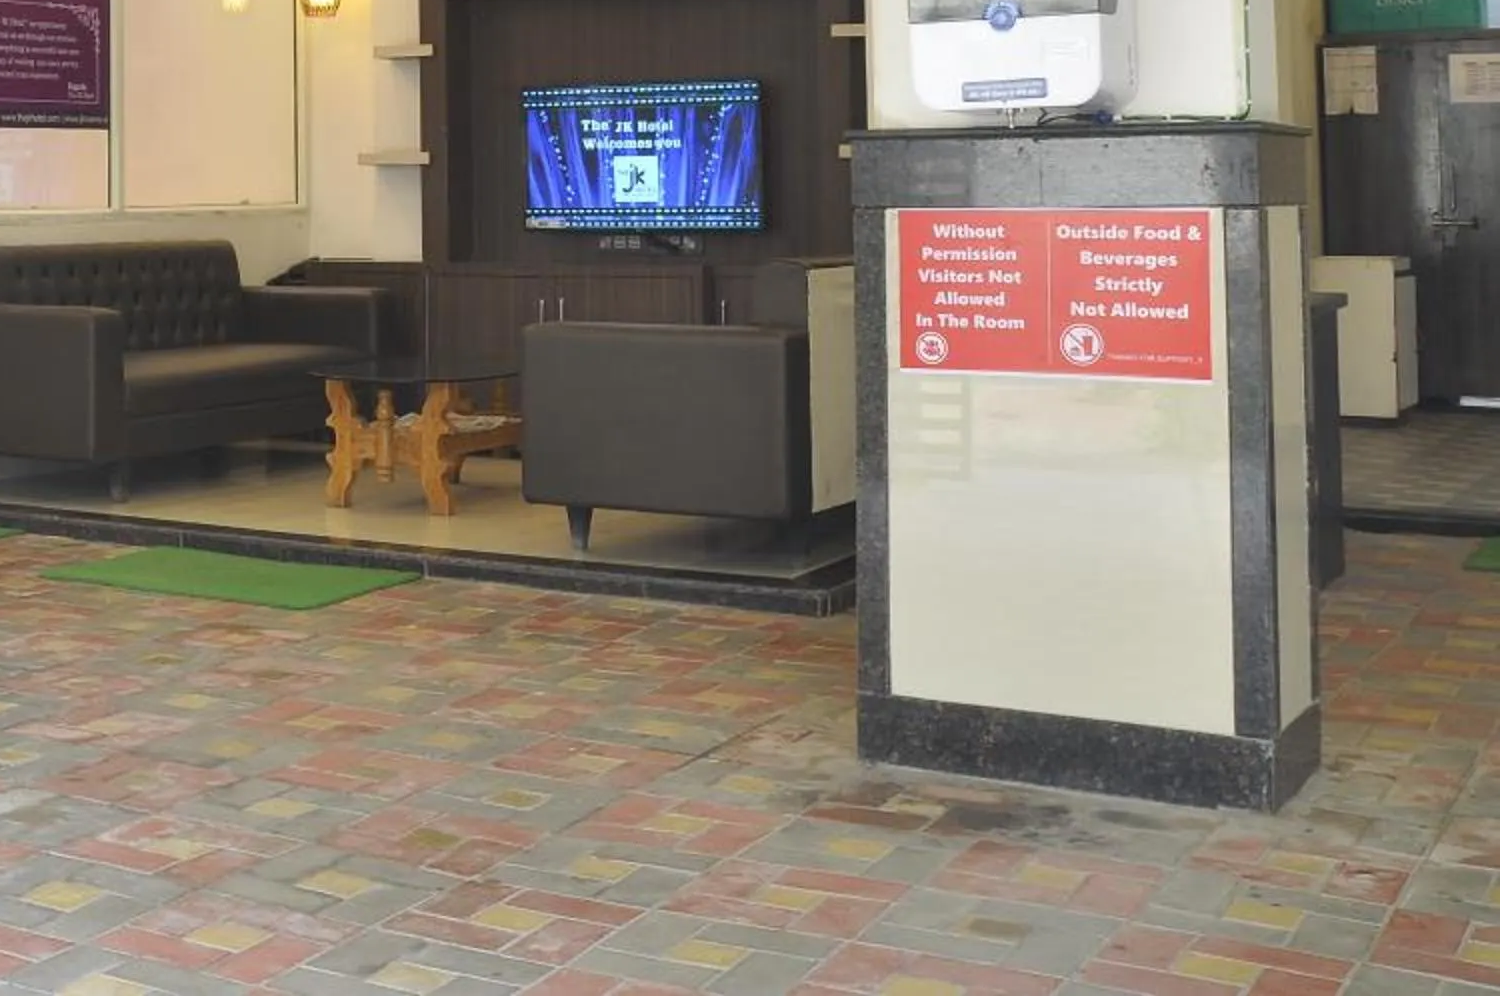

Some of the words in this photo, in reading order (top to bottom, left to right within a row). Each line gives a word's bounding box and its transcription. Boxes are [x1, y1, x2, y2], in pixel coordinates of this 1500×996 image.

[580, 119, 609, 132] The
[615, 121, 633, 133] JK
[582, 137, 652, 151] Welcomes
[654, 139, 682, 151] you
[932, 223, 1005, 238] Without
[1056, 224, 1128, 240] Outside
[1133, 225, 1181, 241] Food
[1187, 225, 1202, 241] &
[921, 246, 1017, 261] Permission
[1079, 250, 1178, 270] Beverages
[918, 268, 984, 283] Visitors
[987, 269, 1022, 284] Not
[1094, 275, 1164, 297] Strictly
[934, 291, 1006, 306] Allowed
[1070, 301, 1107, 317] Not
[1110, 301, 1190, 319] Allowed
[915, 313, 932, 327] In
[937, 313, 969, 328] The
[973, 314, 1025, 329] Room
